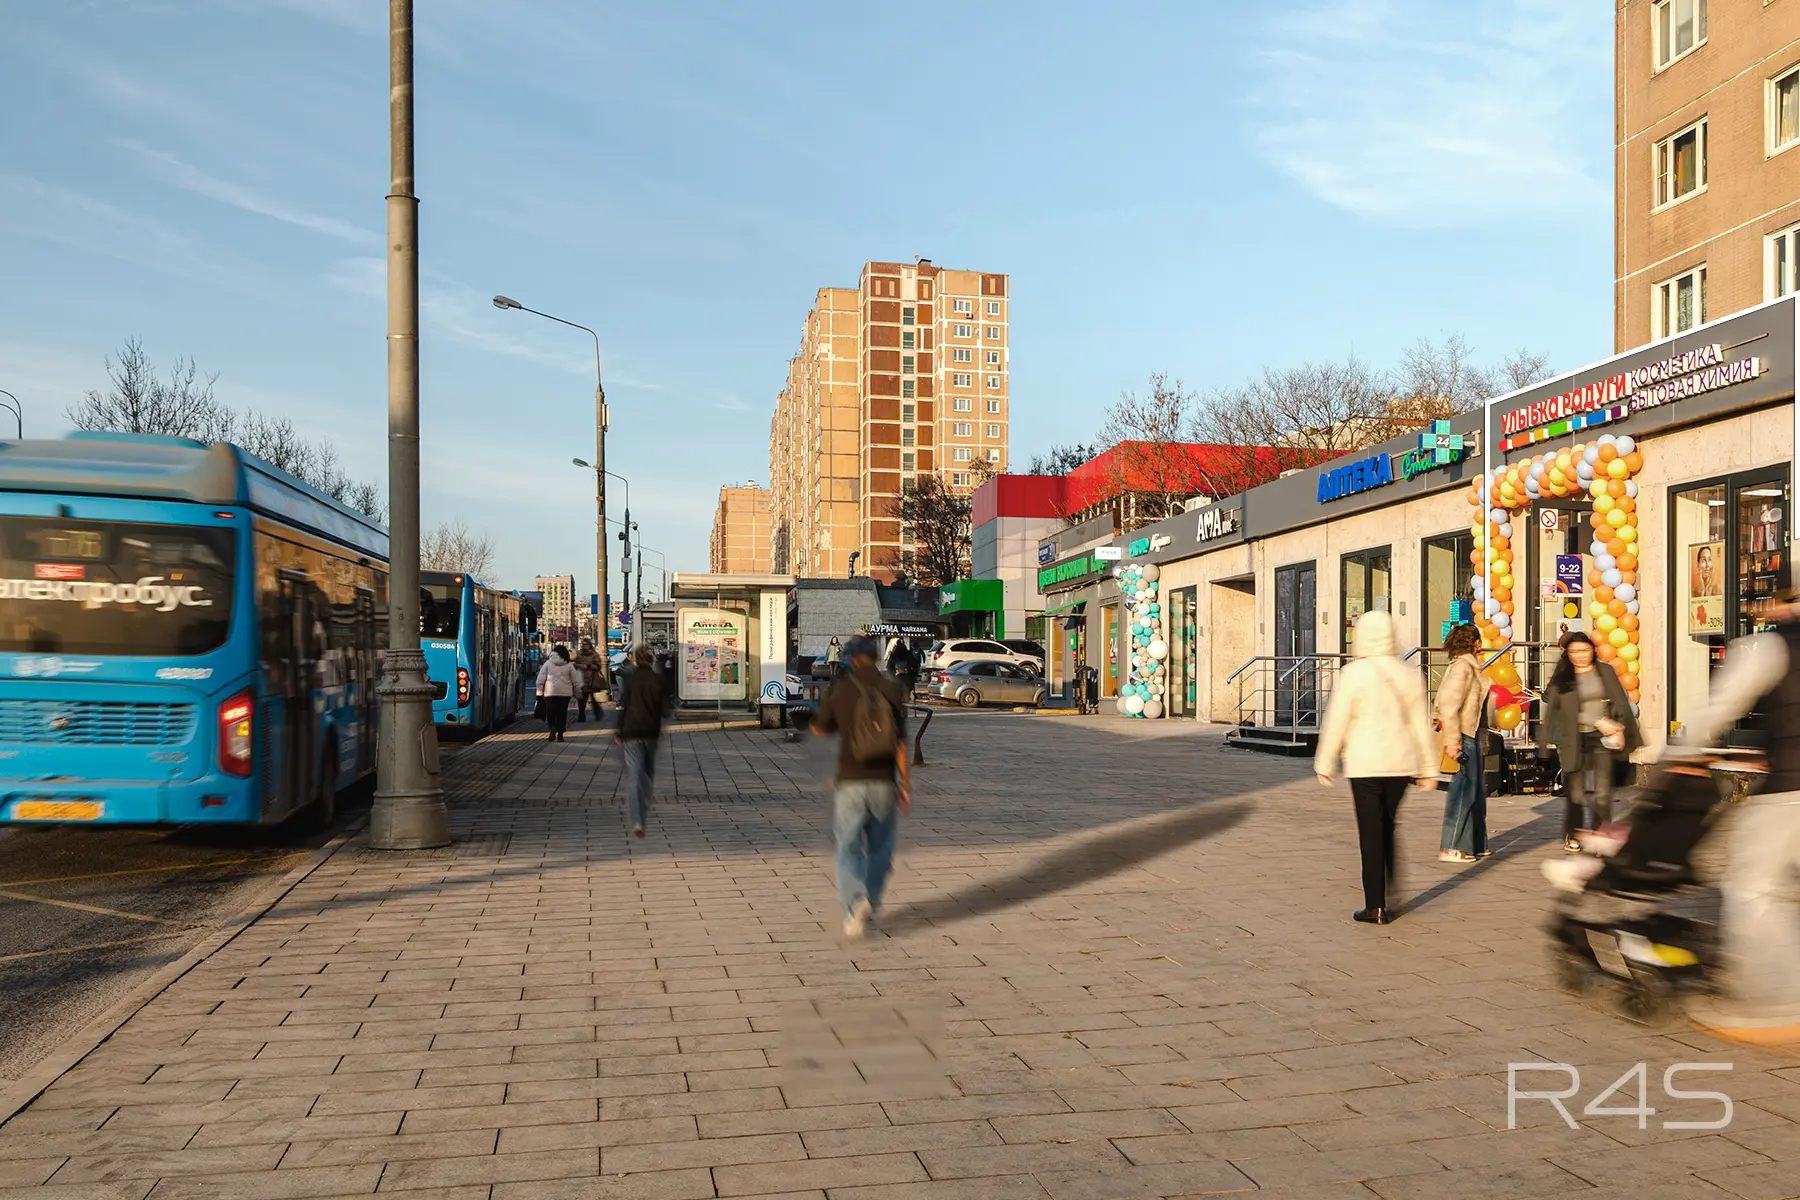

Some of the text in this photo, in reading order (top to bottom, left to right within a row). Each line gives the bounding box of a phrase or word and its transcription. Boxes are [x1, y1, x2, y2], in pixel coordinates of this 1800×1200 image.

[1631, 344, 1722, 389] КОСМЕТИКА
[1630, 357, 1758, 411] БЫТОВАЯ ХИМИЯ
[1436, 436, 1450, 447] 24
[1317, 452, 1391, 503] АПТЕКА
[1559, 563, 1580, 573] 9-22
[861, 623, 899, 633] ШАУРМА
